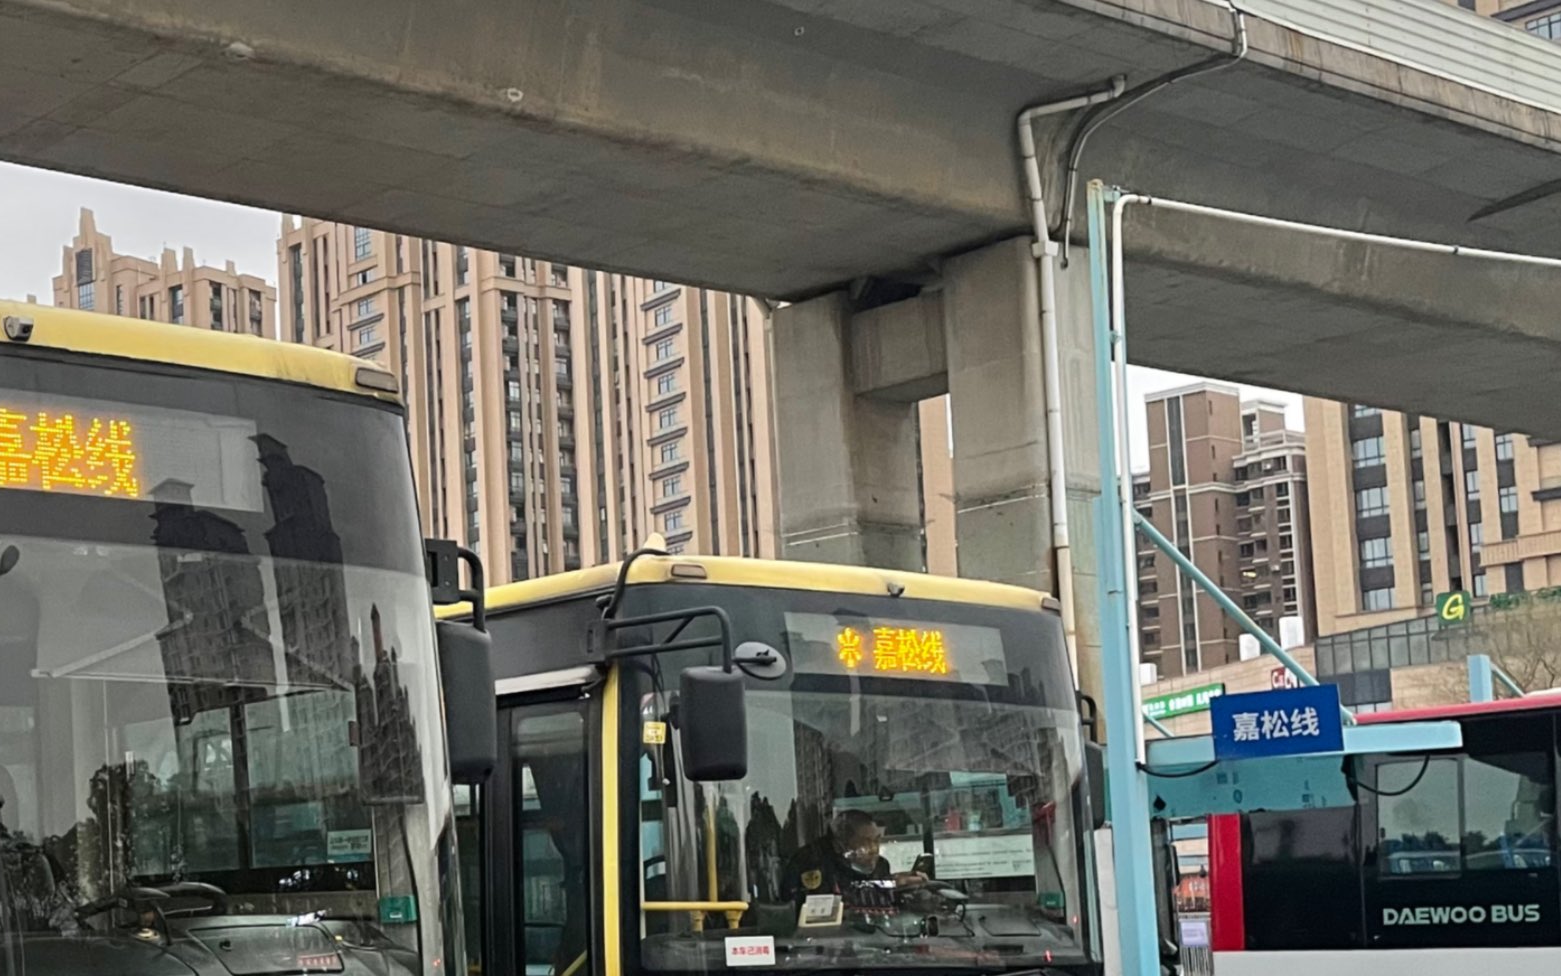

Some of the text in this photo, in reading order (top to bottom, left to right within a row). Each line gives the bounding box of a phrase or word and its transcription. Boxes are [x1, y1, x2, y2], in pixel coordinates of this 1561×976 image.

[872, 627, 947, 674] 嘉松线
[1231, 706, 1321, 742] 嘉松线
[1382, 904, 1541, 925] DAEWOO BUS
